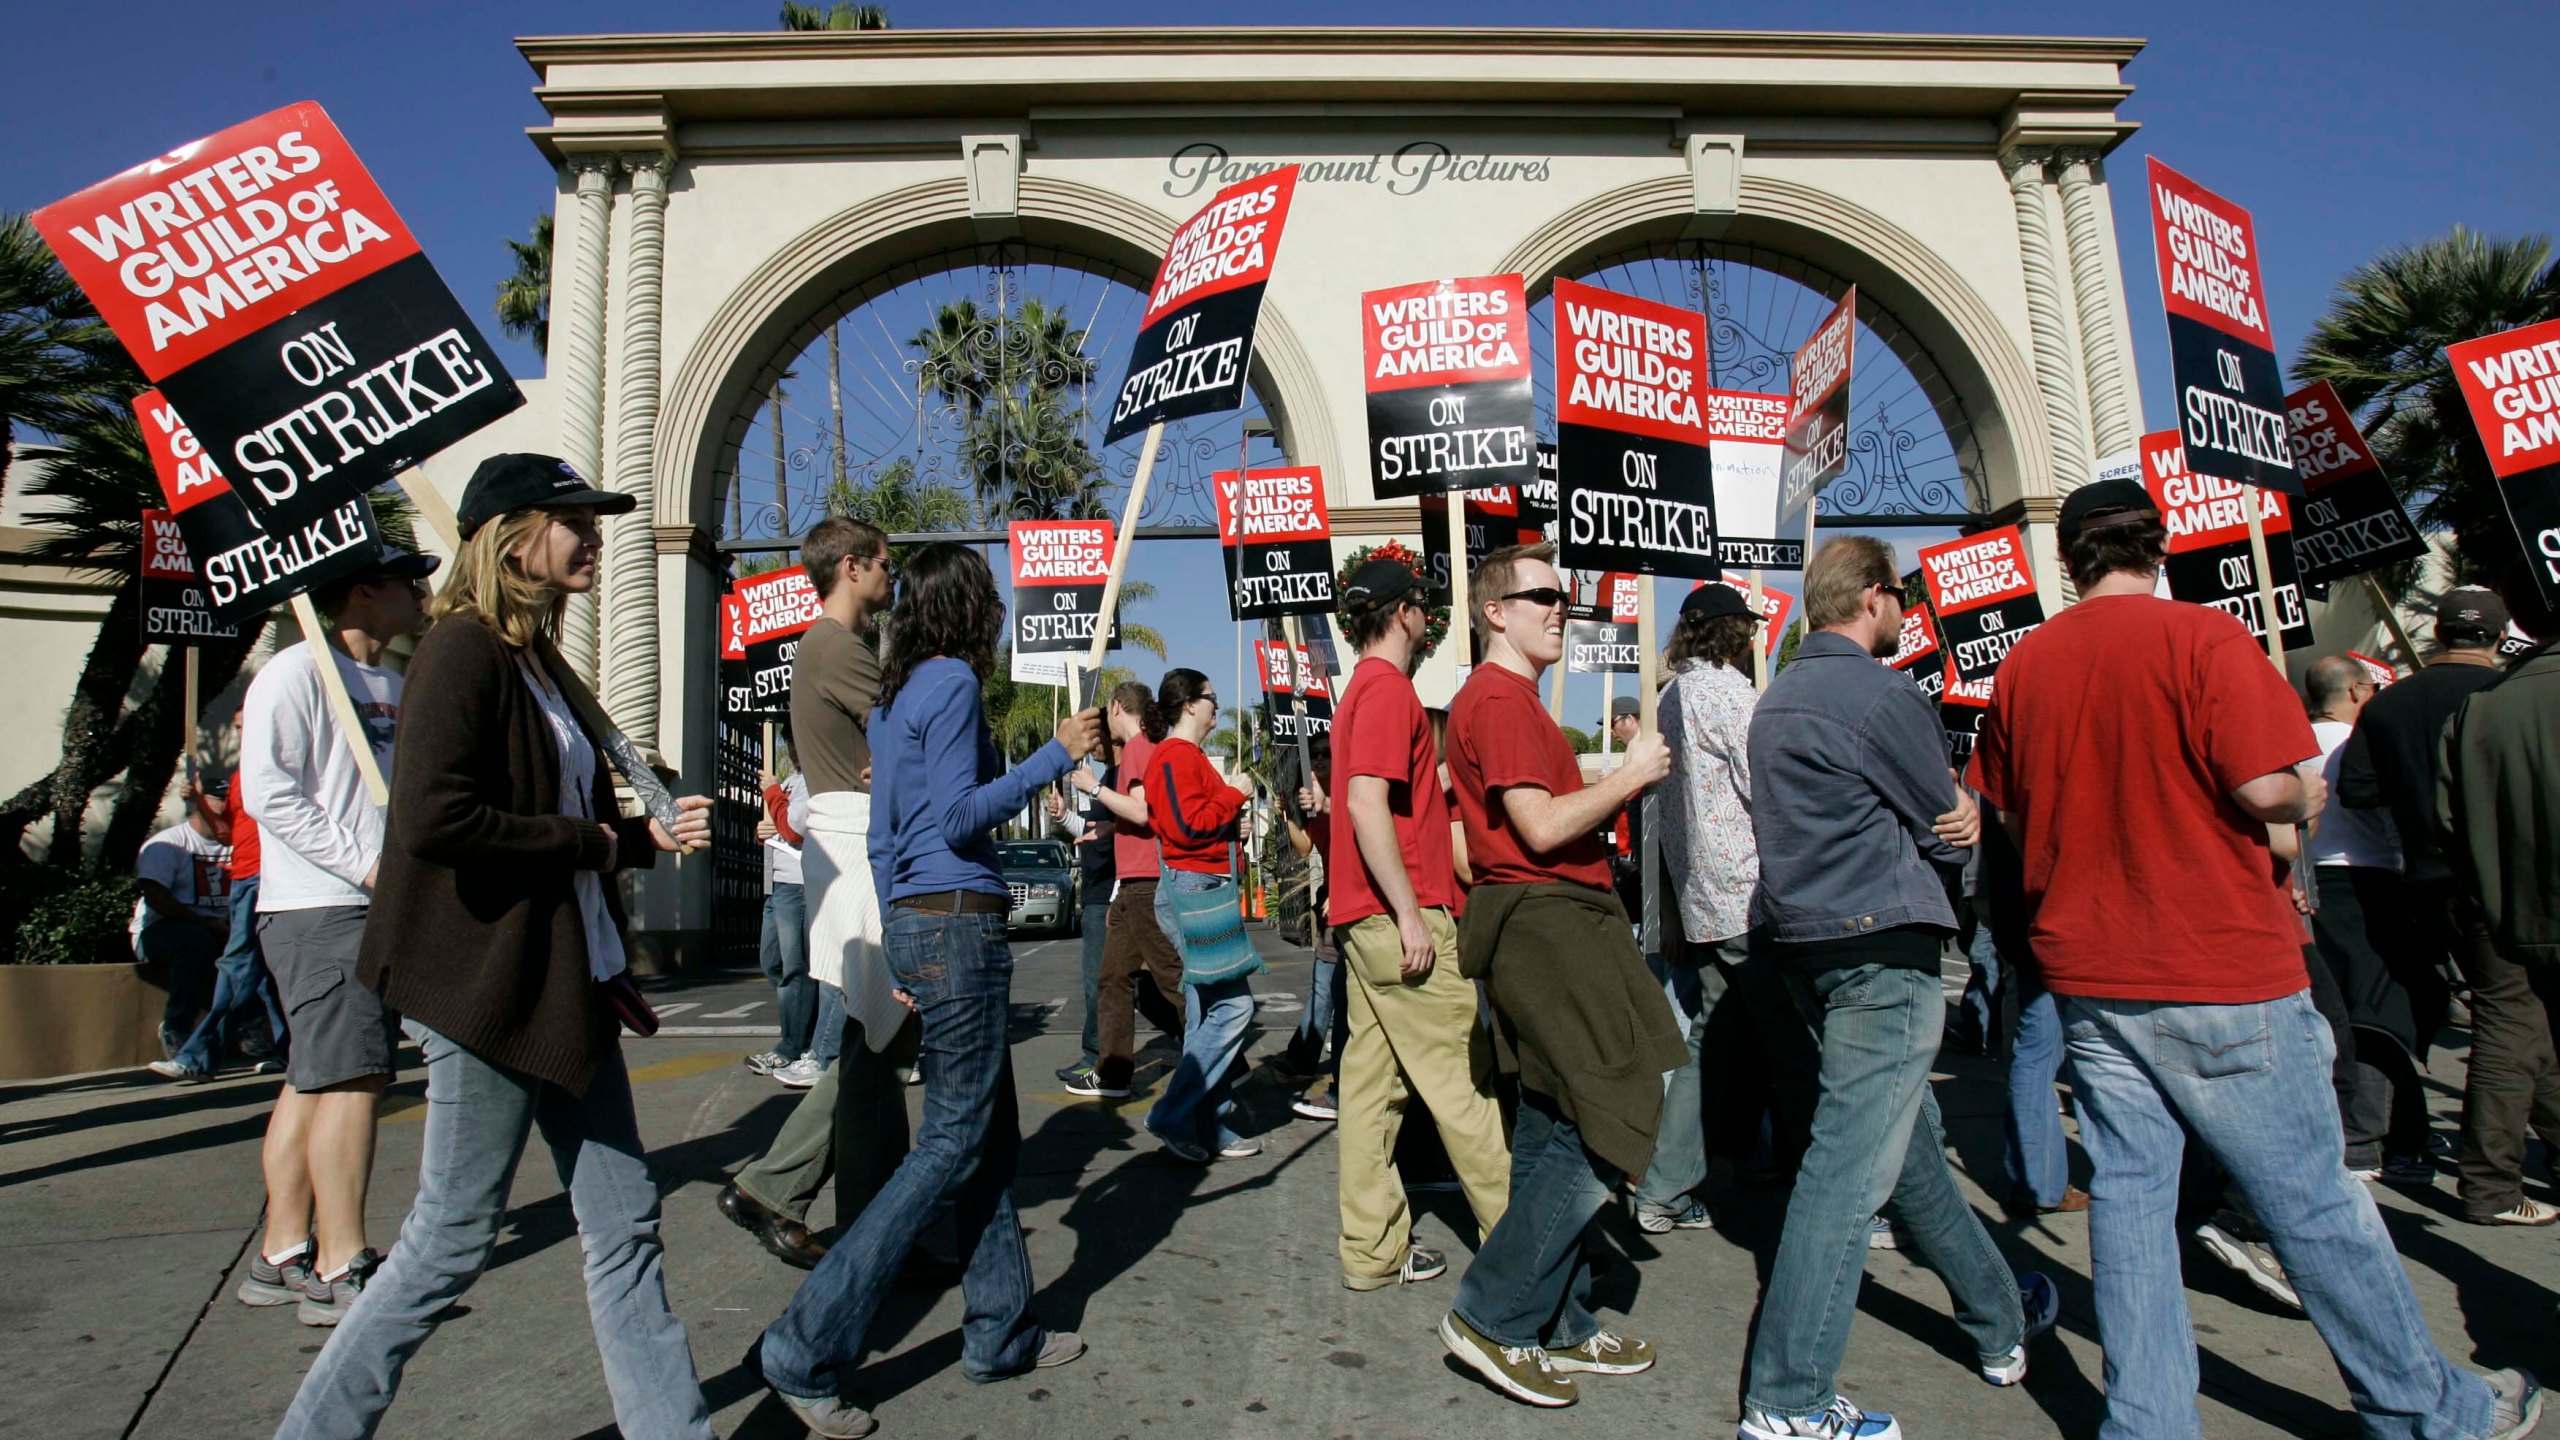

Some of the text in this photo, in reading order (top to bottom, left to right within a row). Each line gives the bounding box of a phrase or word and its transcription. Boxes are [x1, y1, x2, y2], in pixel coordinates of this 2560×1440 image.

[1387, 141, 1550, 196] Pictures
[68, 131, 321, 262] WRITERS
[120, 179, 341, 298] GUILD OF
[1171, 185, 1278, 258] WRITERS
[2156, 182, 2246, 260] WRITERS
[1164, 221, 1267, 282] GUILD OF
[2168, 225, 2251, 292] GUILD OF
[143, 208, 391, 351] AMERICA
[1149, 242, 1263, 316] AMERICA
[2171, 262, 2265, 332] AMERICA
[1373, 290, 1508, 327] WRITERS
[1166, 312, 1201, 353] ON
[1380, 322, 1507, 351] GUILD OF
[1565, 301, 1693, 360] WRITERS
[1796, 307, 1848, 374] WRITERS
[281, 321, 356, 386] ON
[1375, 343, 1519, 378] AMERICA
[1575, 339, 1692, 393] GUILD OF
[1795, 335, 1846, 396] GUILD OF
[2217, 348, 2244, 394] ON
[1114, 338, 1243, 424] STRIKE
[1791, 358, 1847, 423] AMERICA
[234, 328, 494, 506] STRIKE
[1429, 397, 1466, 426] ON
[1569, 374, 1702, 428] AMERICA
[1708, 407, 1785, 426] GUILD OF
[1806, 414, 1823, 448] ON
[2185, 385, 2293, 470] STRIKE
[2311, 427, 2337, 449] OF
[1380, 426, 1528, 480] STRIKE
[1622, 450, 1657, 490] ON
[1785, 422, 1844, 505] STRIKE
[1221, 477, 1313, 498] WRITERS
[1293, 499, 1313, 513] OF
[1570, 487, 1711, 556] STRIKE
[2166, 491, 2282, 538] AMERIA
[2305, 498, 2340, 526] ON
[1017, 529, 1104, 546] WRITERS
[1023, 545, 1102, 561] GUILD OF
[1719, 542, 1801, 565] TRIKE
[1927, 537, 2012, 573] WRITERS
[1020, 561, 1111, 578] AMERICA
[1266, 551, 1290, 571] ON
[1937, 558, 2015, 588] GUILD OF
[2219, 555, 2252, 590] ON
[182, 589, 205, 607] ON
[749, 593, 800, 618] GUILD
[800, 591, 818, 605] OF
[1053, 593, 1077, 611] ON
[1235, 572, 1332, 608] STRIKE
[1940, 570, 2027, 607] AMERICA
[748, 603, 823, 636] AMERICA
[1599, 628, 1617, 641] ON
[1910, 627, 1923, 640] OF
[1980, 610, 2004, 633] ON
